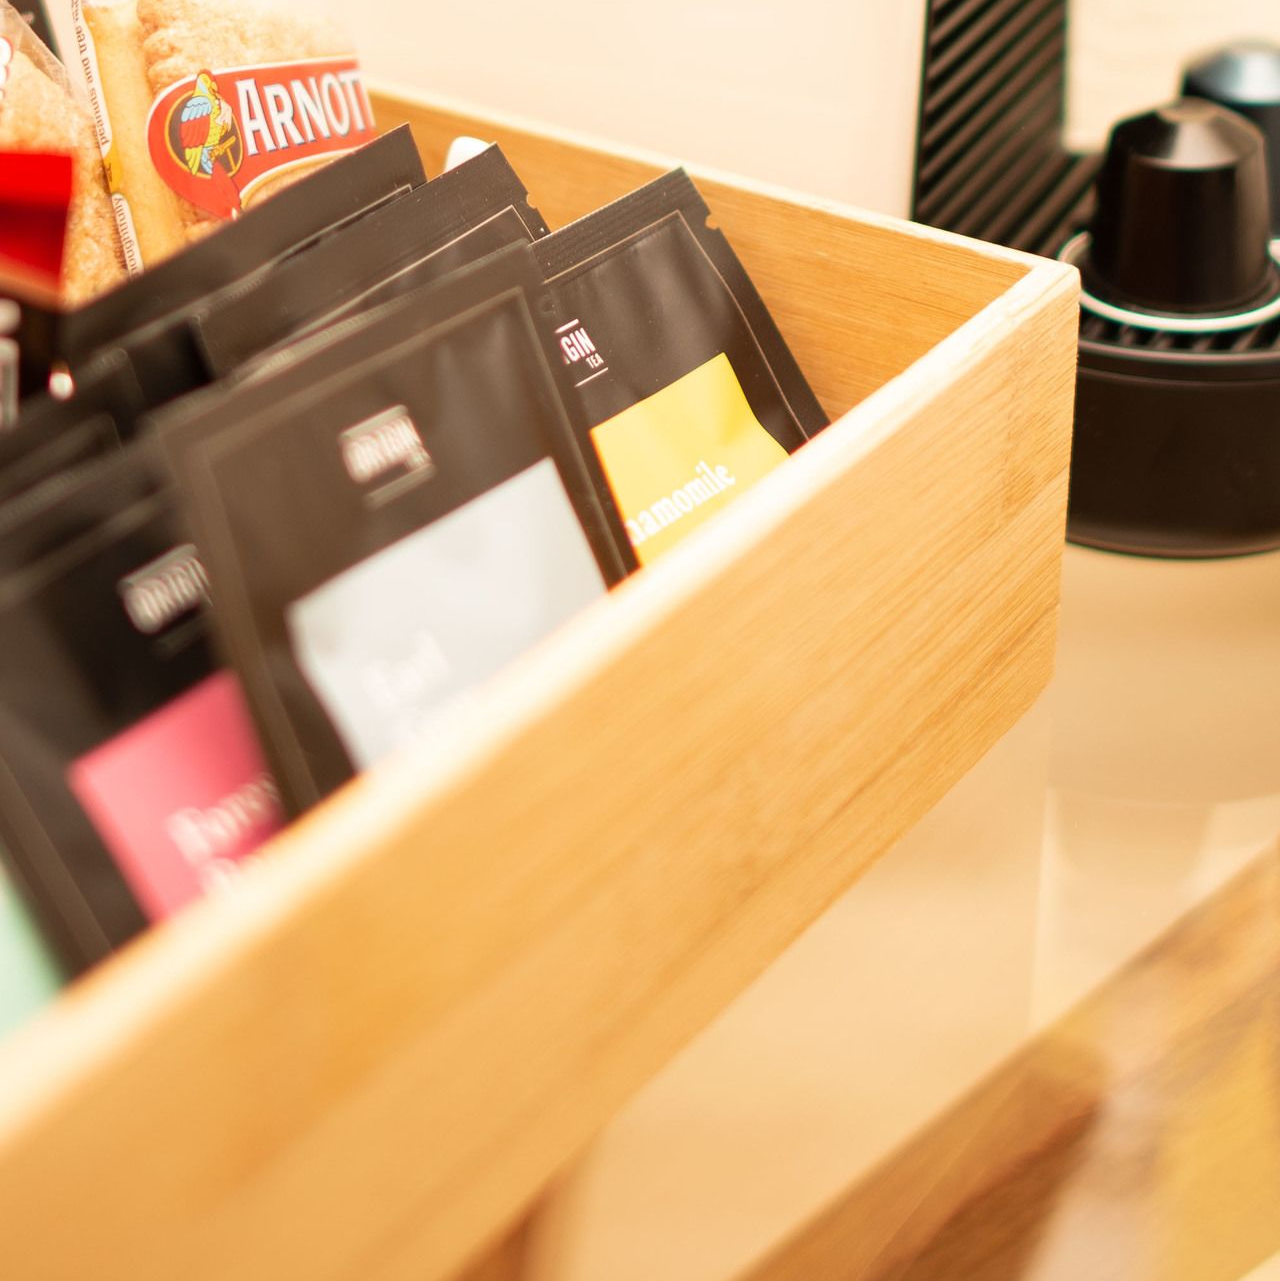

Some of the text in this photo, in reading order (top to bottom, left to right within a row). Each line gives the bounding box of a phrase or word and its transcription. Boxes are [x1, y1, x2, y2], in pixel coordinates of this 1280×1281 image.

[81, 57, 95, 85] and
[89, 87, 110, 146] peanuts
[560, 327, 596, 363] GIN
[585, 353, 604, 369] TEA
[625, 460, 736, 546] amomile
